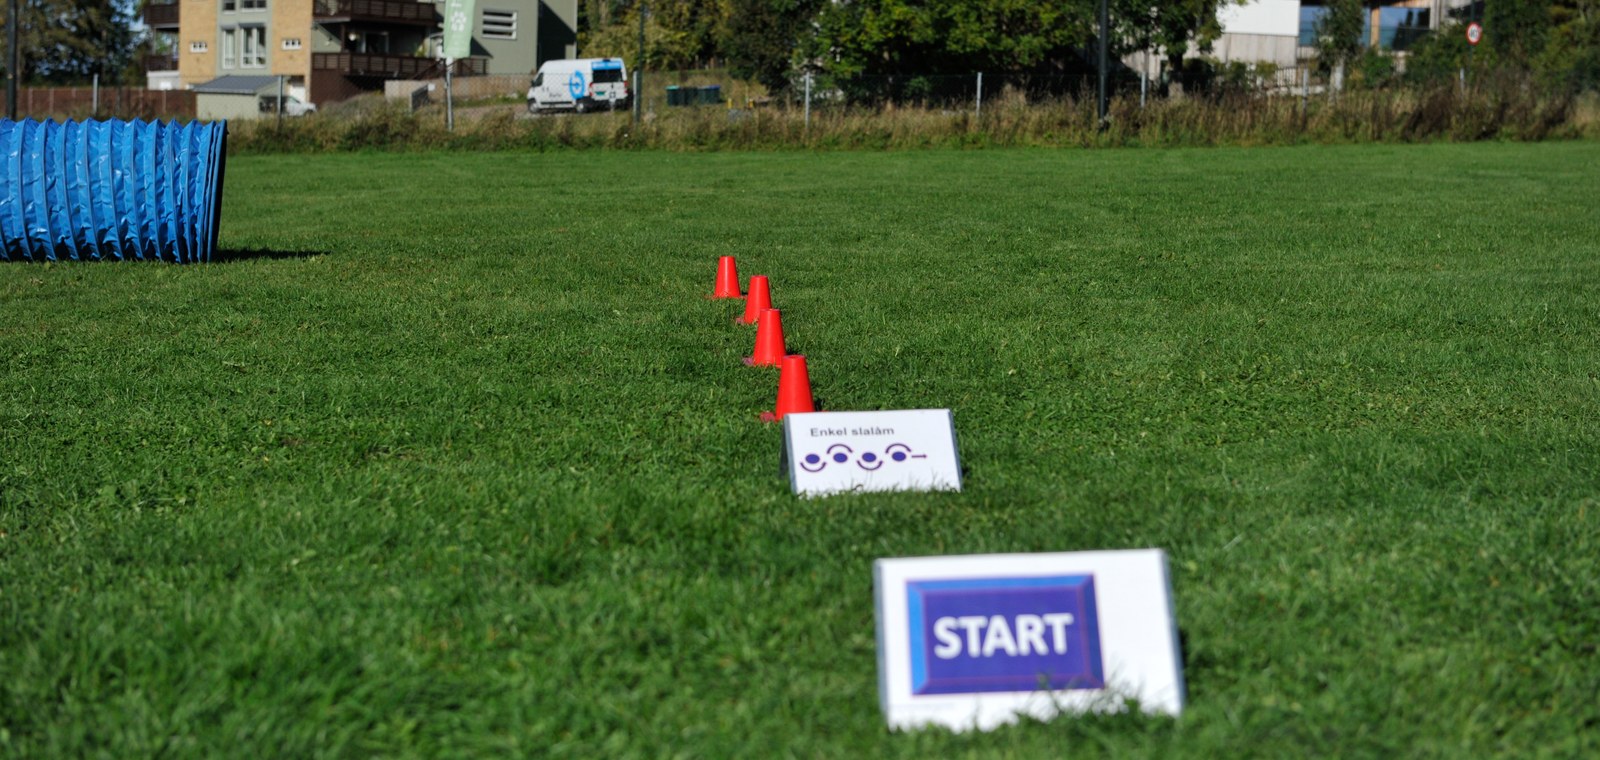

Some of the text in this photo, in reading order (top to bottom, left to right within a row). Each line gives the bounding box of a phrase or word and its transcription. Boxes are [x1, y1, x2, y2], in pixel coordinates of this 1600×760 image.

[810, 426, 895, 437] Enkel slalåm
[933, 613, 1074, 659] START
